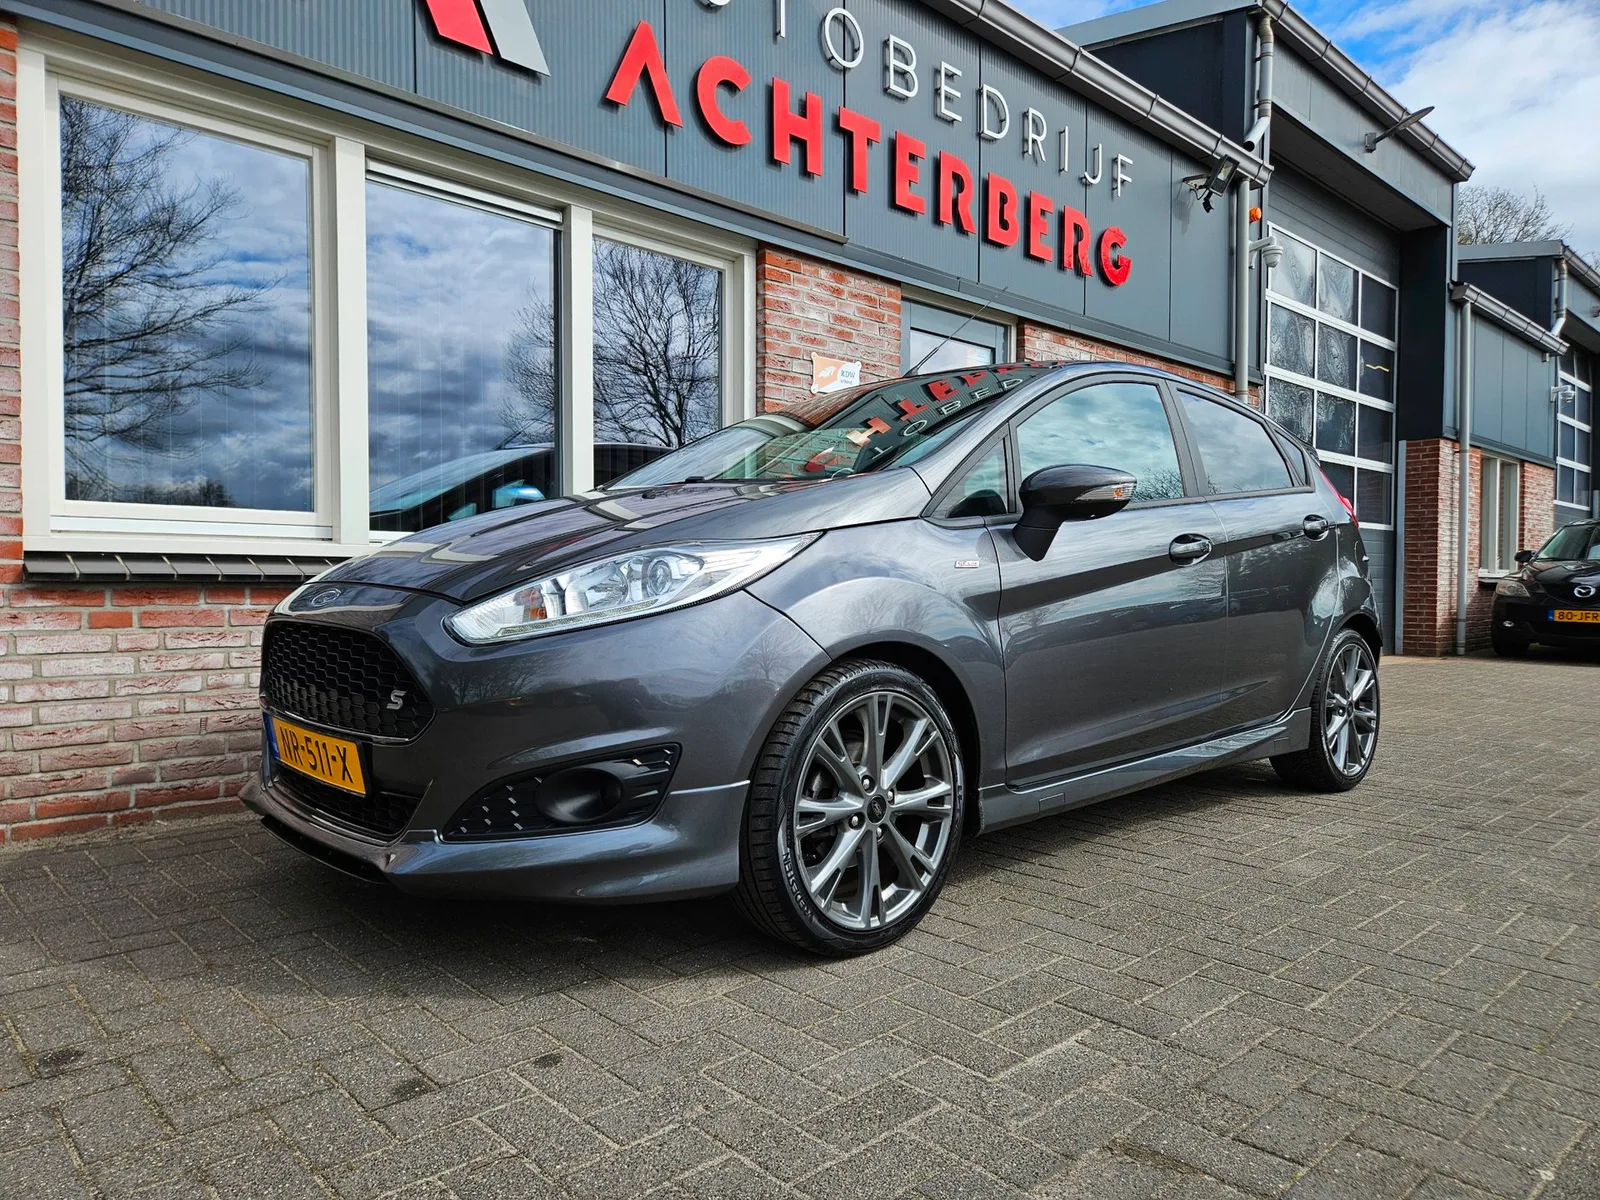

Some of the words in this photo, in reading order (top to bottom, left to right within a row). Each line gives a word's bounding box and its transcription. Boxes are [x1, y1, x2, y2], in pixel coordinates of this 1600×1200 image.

[605, 20, 1132, 287] ACHTERBERG
[699, 0, 1134, 198] OBEDRIJF
[279, 725, 354, 784] NR-511-X
